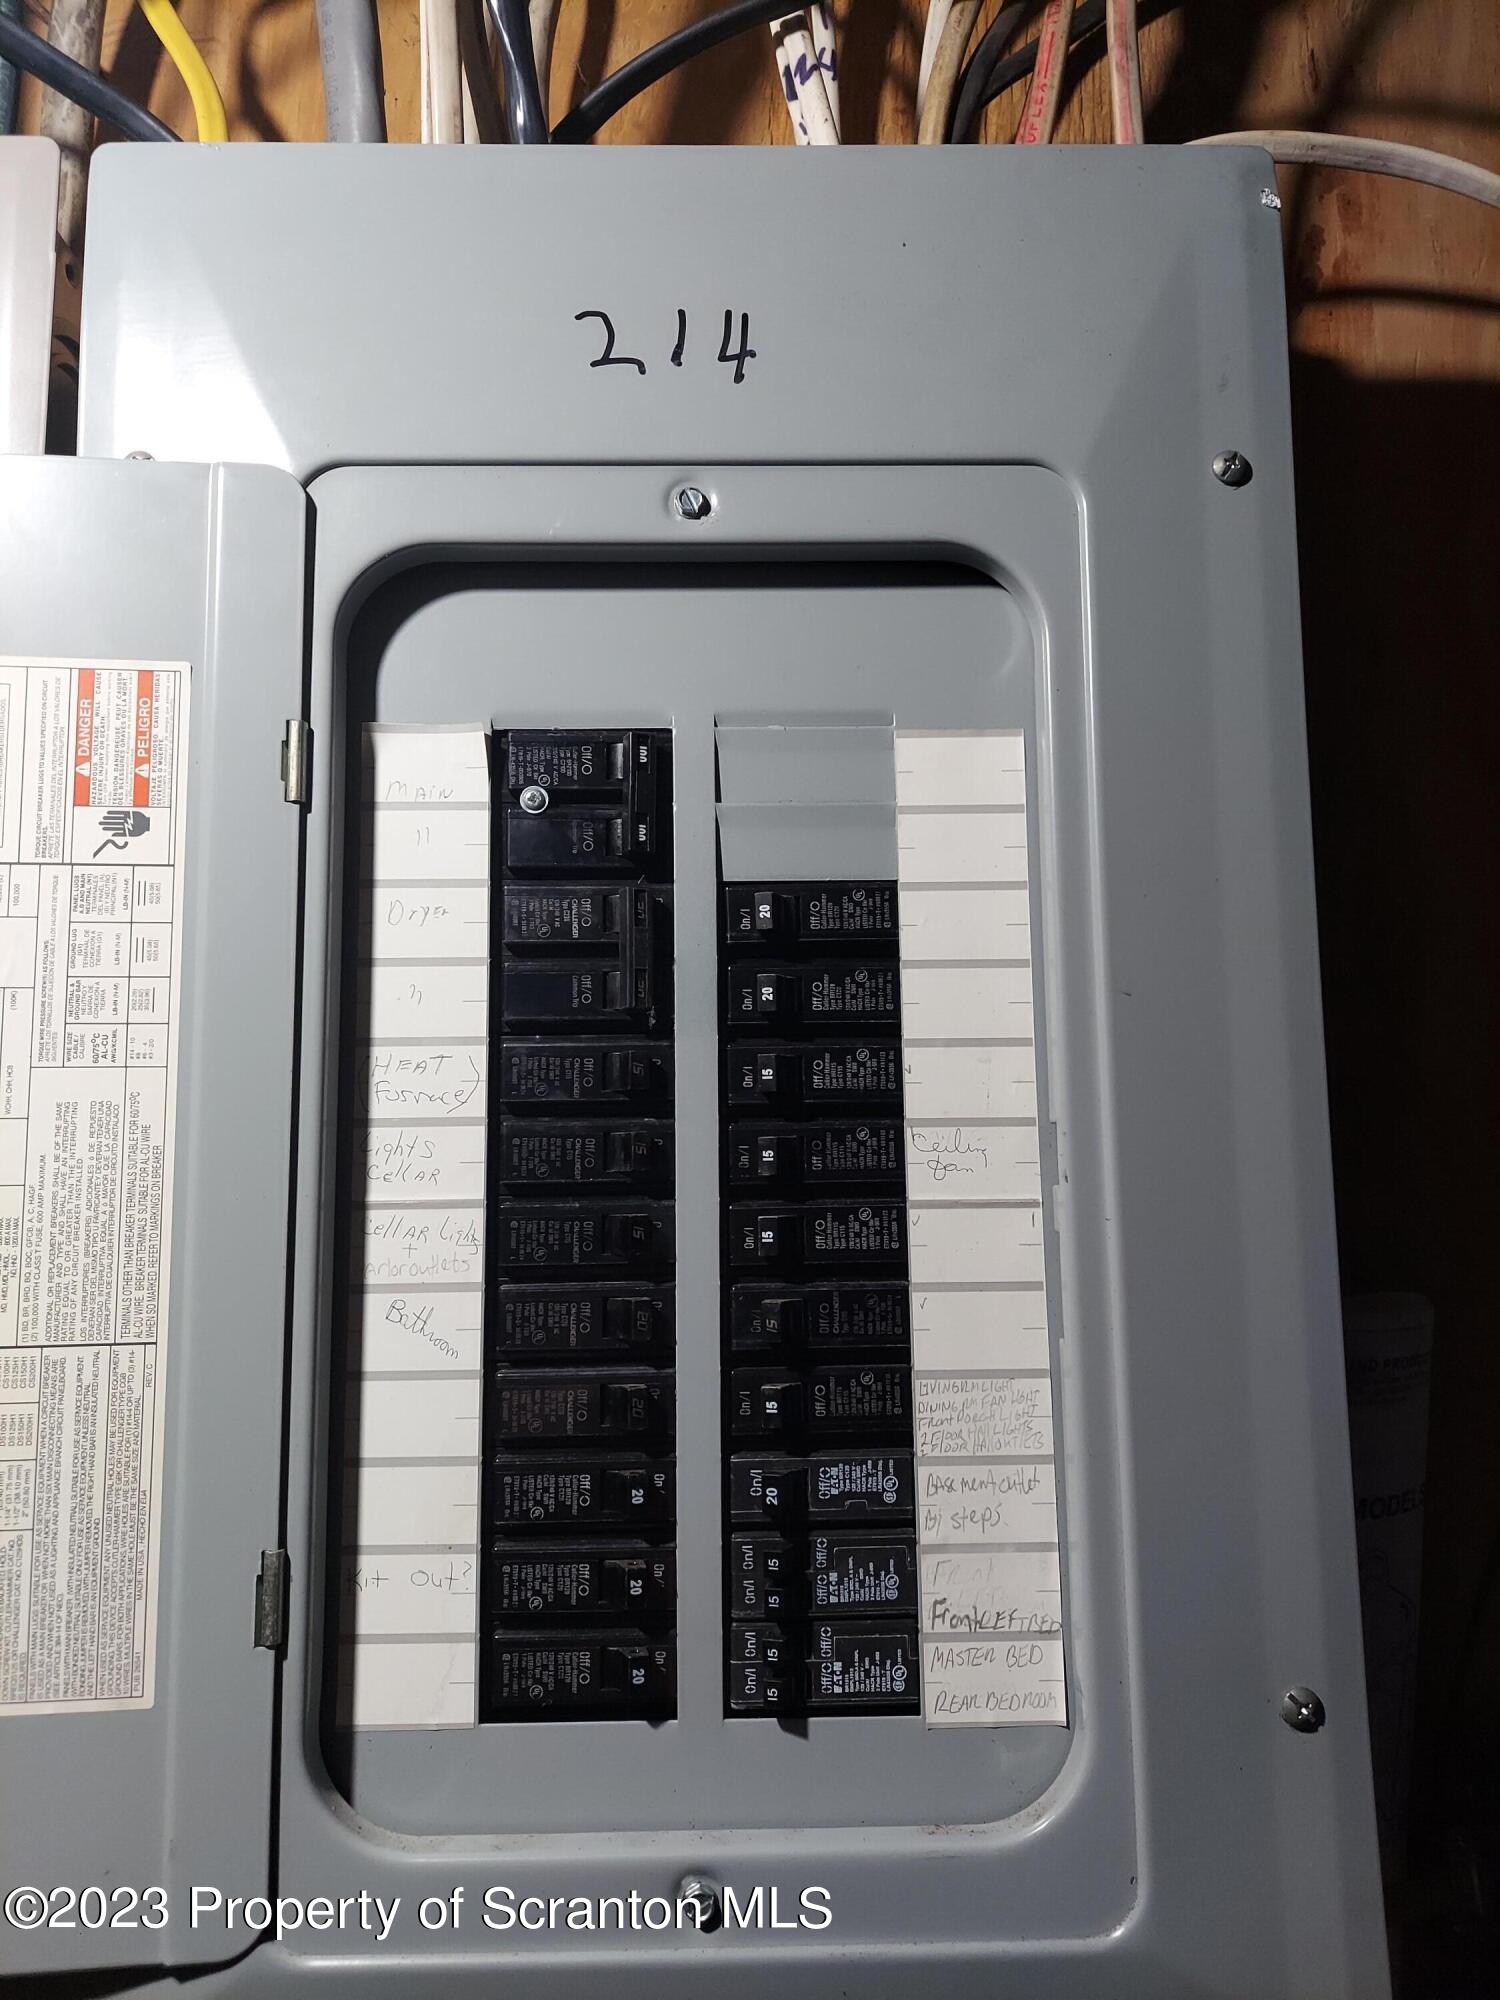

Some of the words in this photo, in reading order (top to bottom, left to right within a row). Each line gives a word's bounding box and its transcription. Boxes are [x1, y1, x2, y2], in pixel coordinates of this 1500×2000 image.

[78, 698, 92, 757] DANGER
[137, 696, 151, 758] PELIGRO
[758, 904, 772, 919] 20
[761, 986, 774, 1002] 20
[101, 1034, 109, 1060] AL-CU
[761, 1068, 774, 1080] 15
[128, 1119, 139, 1135] FOR
[141, 1124, 151, 1143] WIRE
[127, 1137, 138, 1170] SUITABLE
[151, 1145, 162, 1179] BREAKER
[762, 1149, 775, 1162] 15
[139, 1166, 150, 1182] FOR
[126, 1172, 137, 1212] TERMINALS
[150, 1180, 161, 1191] ON
[138, 1183, 149, 1215] SUITABLE
[149, 1193, 160, 1231] MARKINGS
[124, 1214, 135, 1248] BREAKER
[136, 1217, 147, 1256] TERMINALS
[149, 1232, 159, 1242] TO
[761, 1230, 774, 1243] 15
[123, 1250, 134, 1269] THAN
[148, 1244, 159, 1269] REFER
[122, 1271, 133, 1295] OTHER
[135, 1256, 146, 1291] BREAKER
[120, 1297, 132, 1339] TERMINALS
[146, 1304, 156, 1315] SO
[133, 1317, 144, 1338] AL-CU
[145, 1316, 156, 1339] WHEN
[765, 1400, 778, 1414] 15
[631, 1488, 644, 1505] 20
[766, 1487, 778, 1506] 20
[768, 1557, 780, 1571] 15
[629, 1579, 643, 1596] 20
[768, 1595, 780, 1608] 15
[767, 1647, 779, 1661] 15
[1005, 1644, 1043, 1669] BED
[632, 1668, 645, 1685] 20
[767, 1687, 779, 1701] 15
